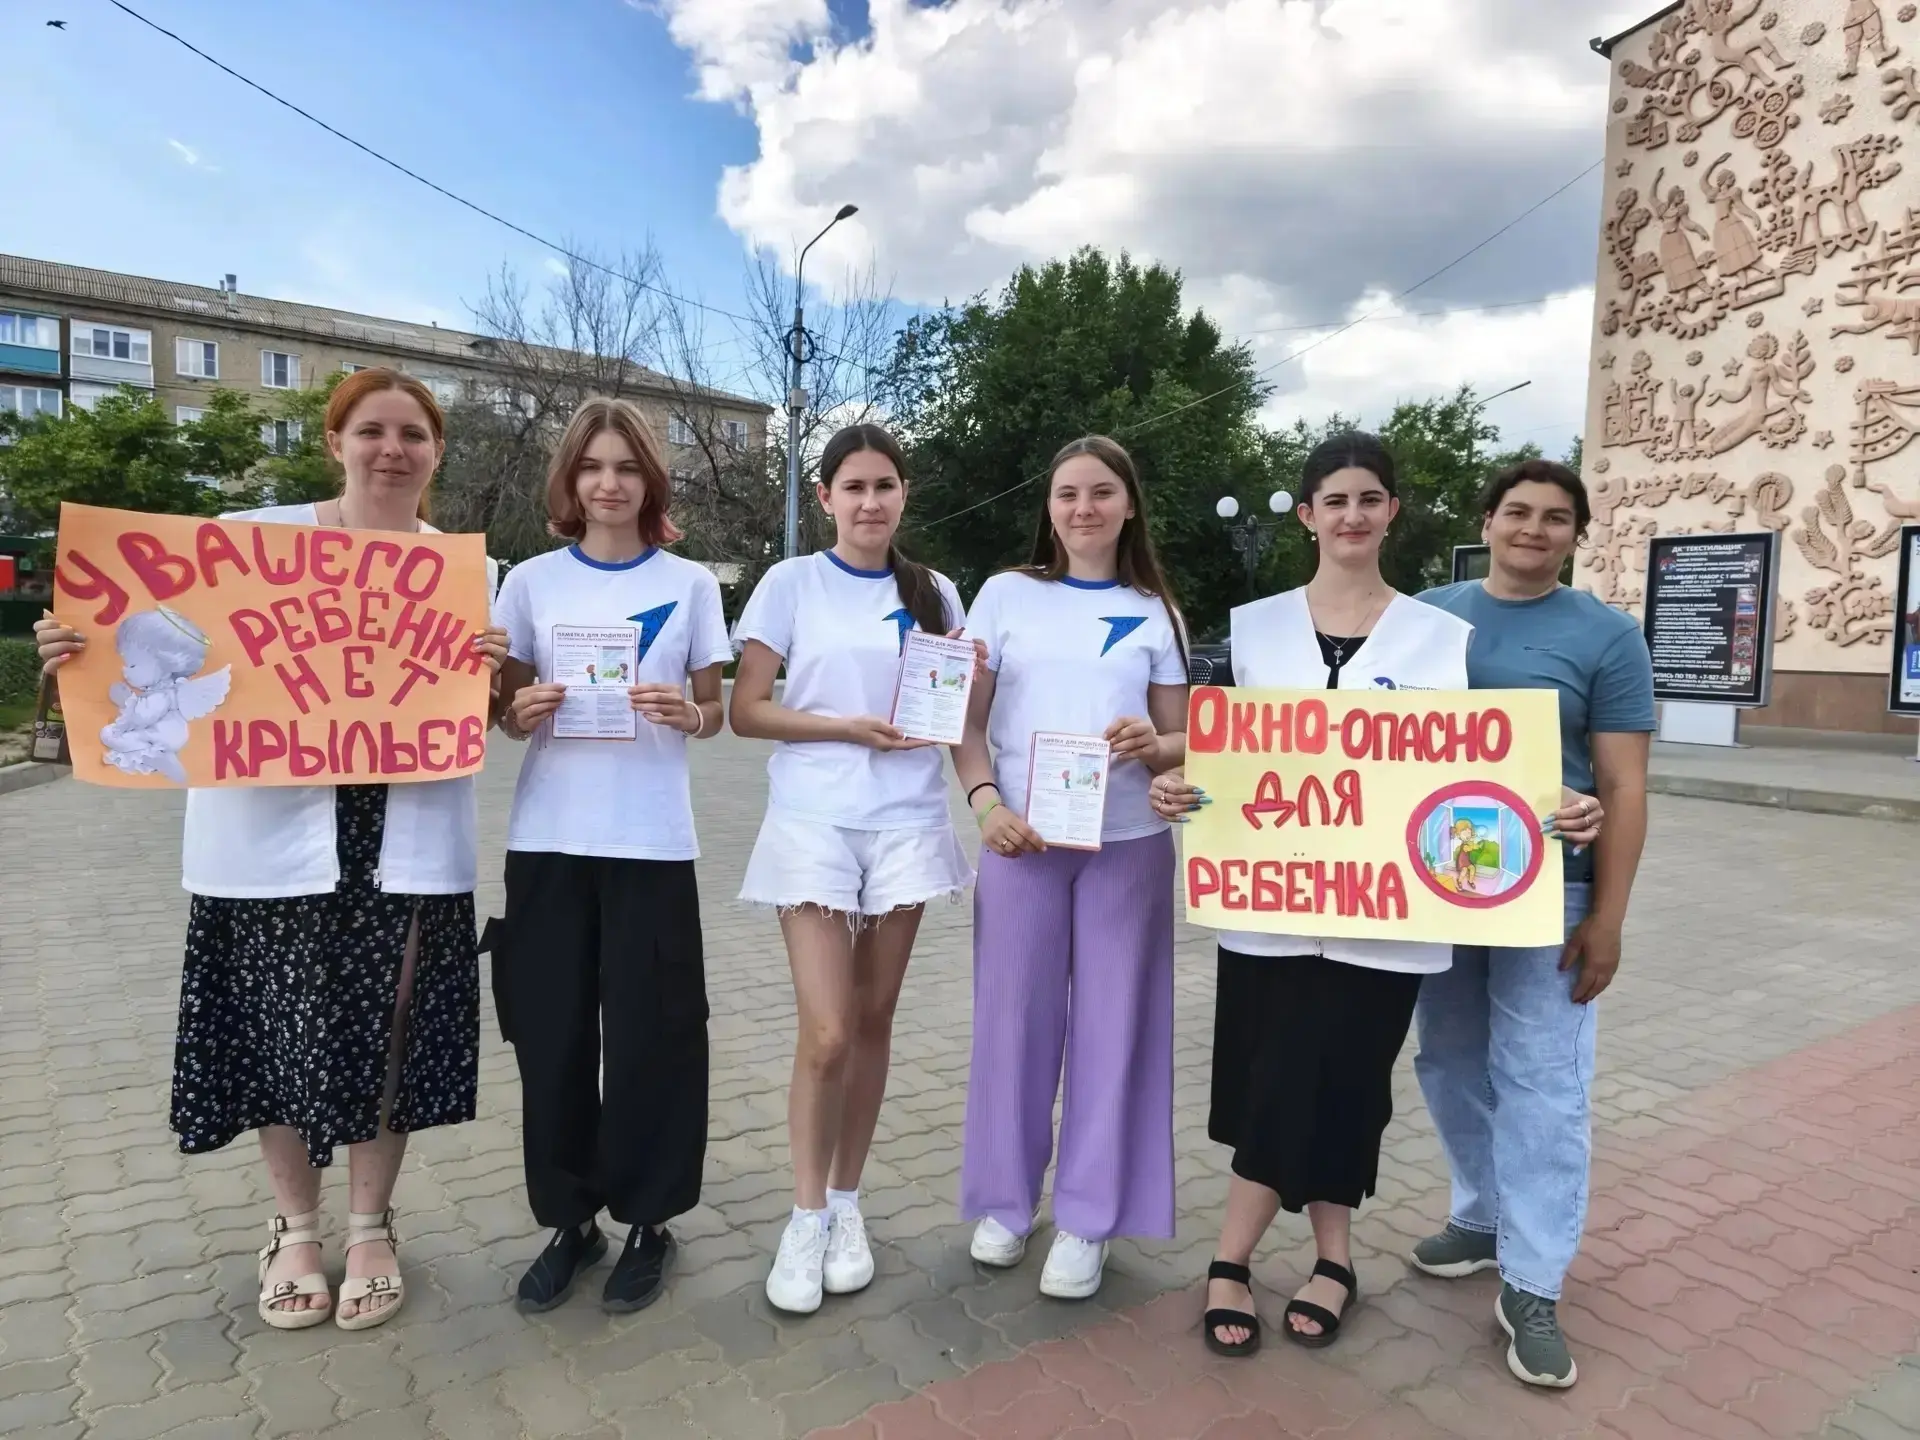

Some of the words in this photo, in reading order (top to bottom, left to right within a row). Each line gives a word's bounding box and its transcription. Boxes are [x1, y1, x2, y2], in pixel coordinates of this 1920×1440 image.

[56, 549, 130, 626] У
[117, 522, 444, 601] ВАШЕГО
[213, 714, 486, 781] КРЫЛЬЕВ
[1241, 769, 1363, 831] ДЛЯ
[1188, 851, 1409, 921] РЕБЁНКА
